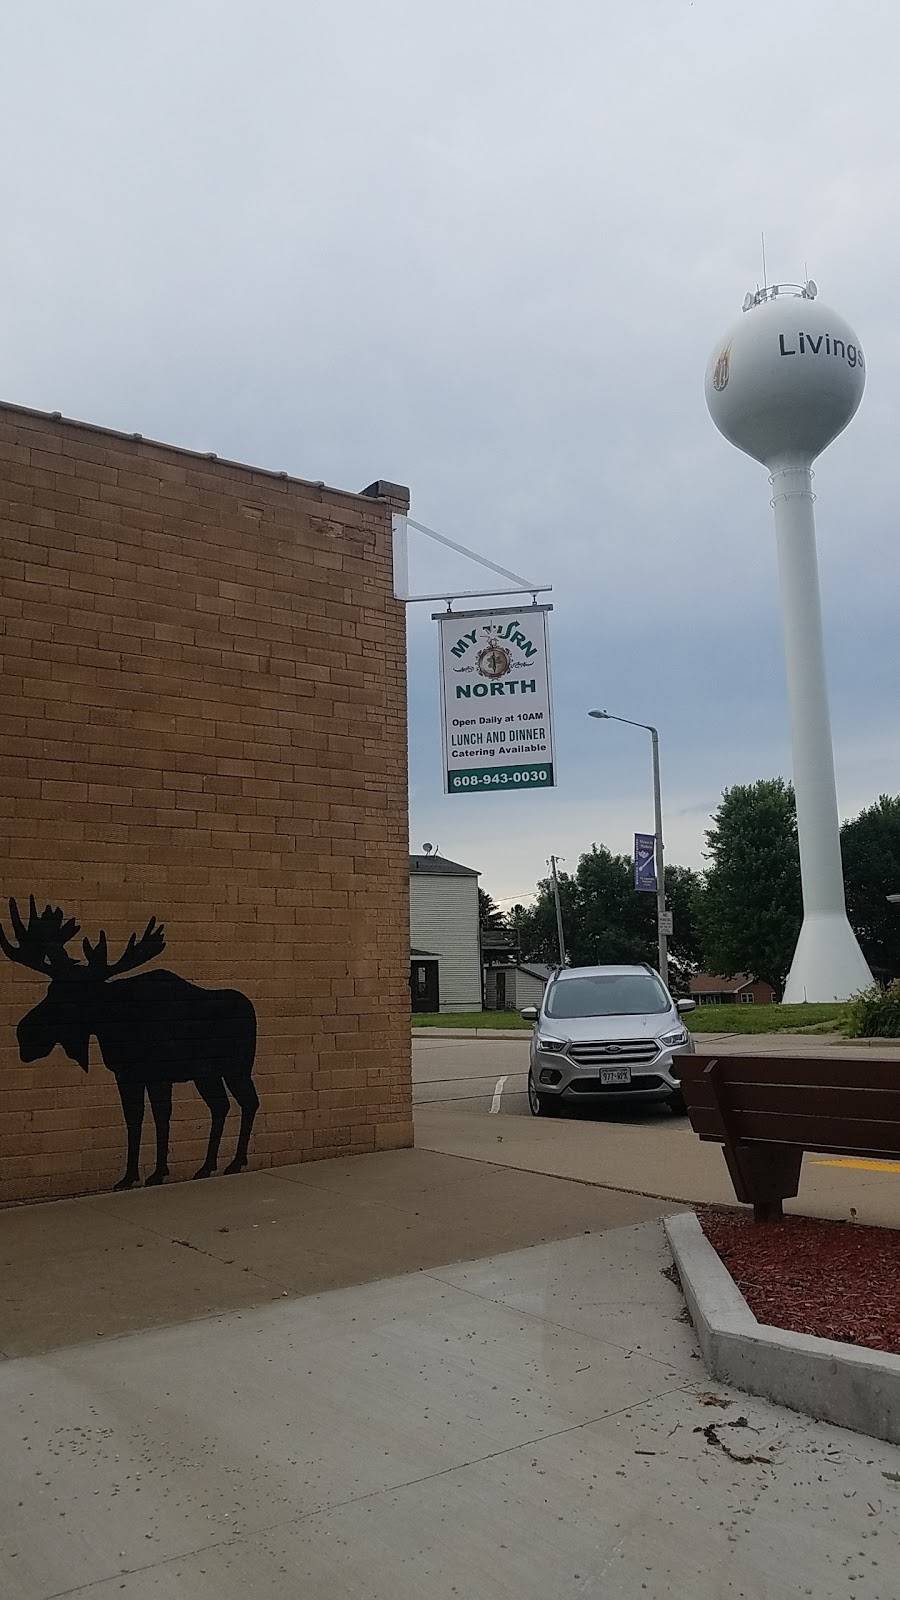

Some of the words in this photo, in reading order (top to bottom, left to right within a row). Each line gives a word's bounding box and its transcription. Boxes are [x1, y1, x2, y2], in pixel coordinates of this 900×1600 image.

[450, 629, 478, 659] MY
[456, 679, 536, 699] NORTH
[452, 719, 476, 728] Open
[479, 716, 503, 725] Daily
[504, 714, 515, 723] at
[517, 712, 544, 721] 10AM
[451, 732, 483, 747] LUNCH
[486, 730, 506, 744] AND
[509, 727, 546, 742] DINNER
[451, 748, 495, 758] Catering
[499, 744, 547, 754] Available
[453, 770, 547, 787] 608-943-0030
